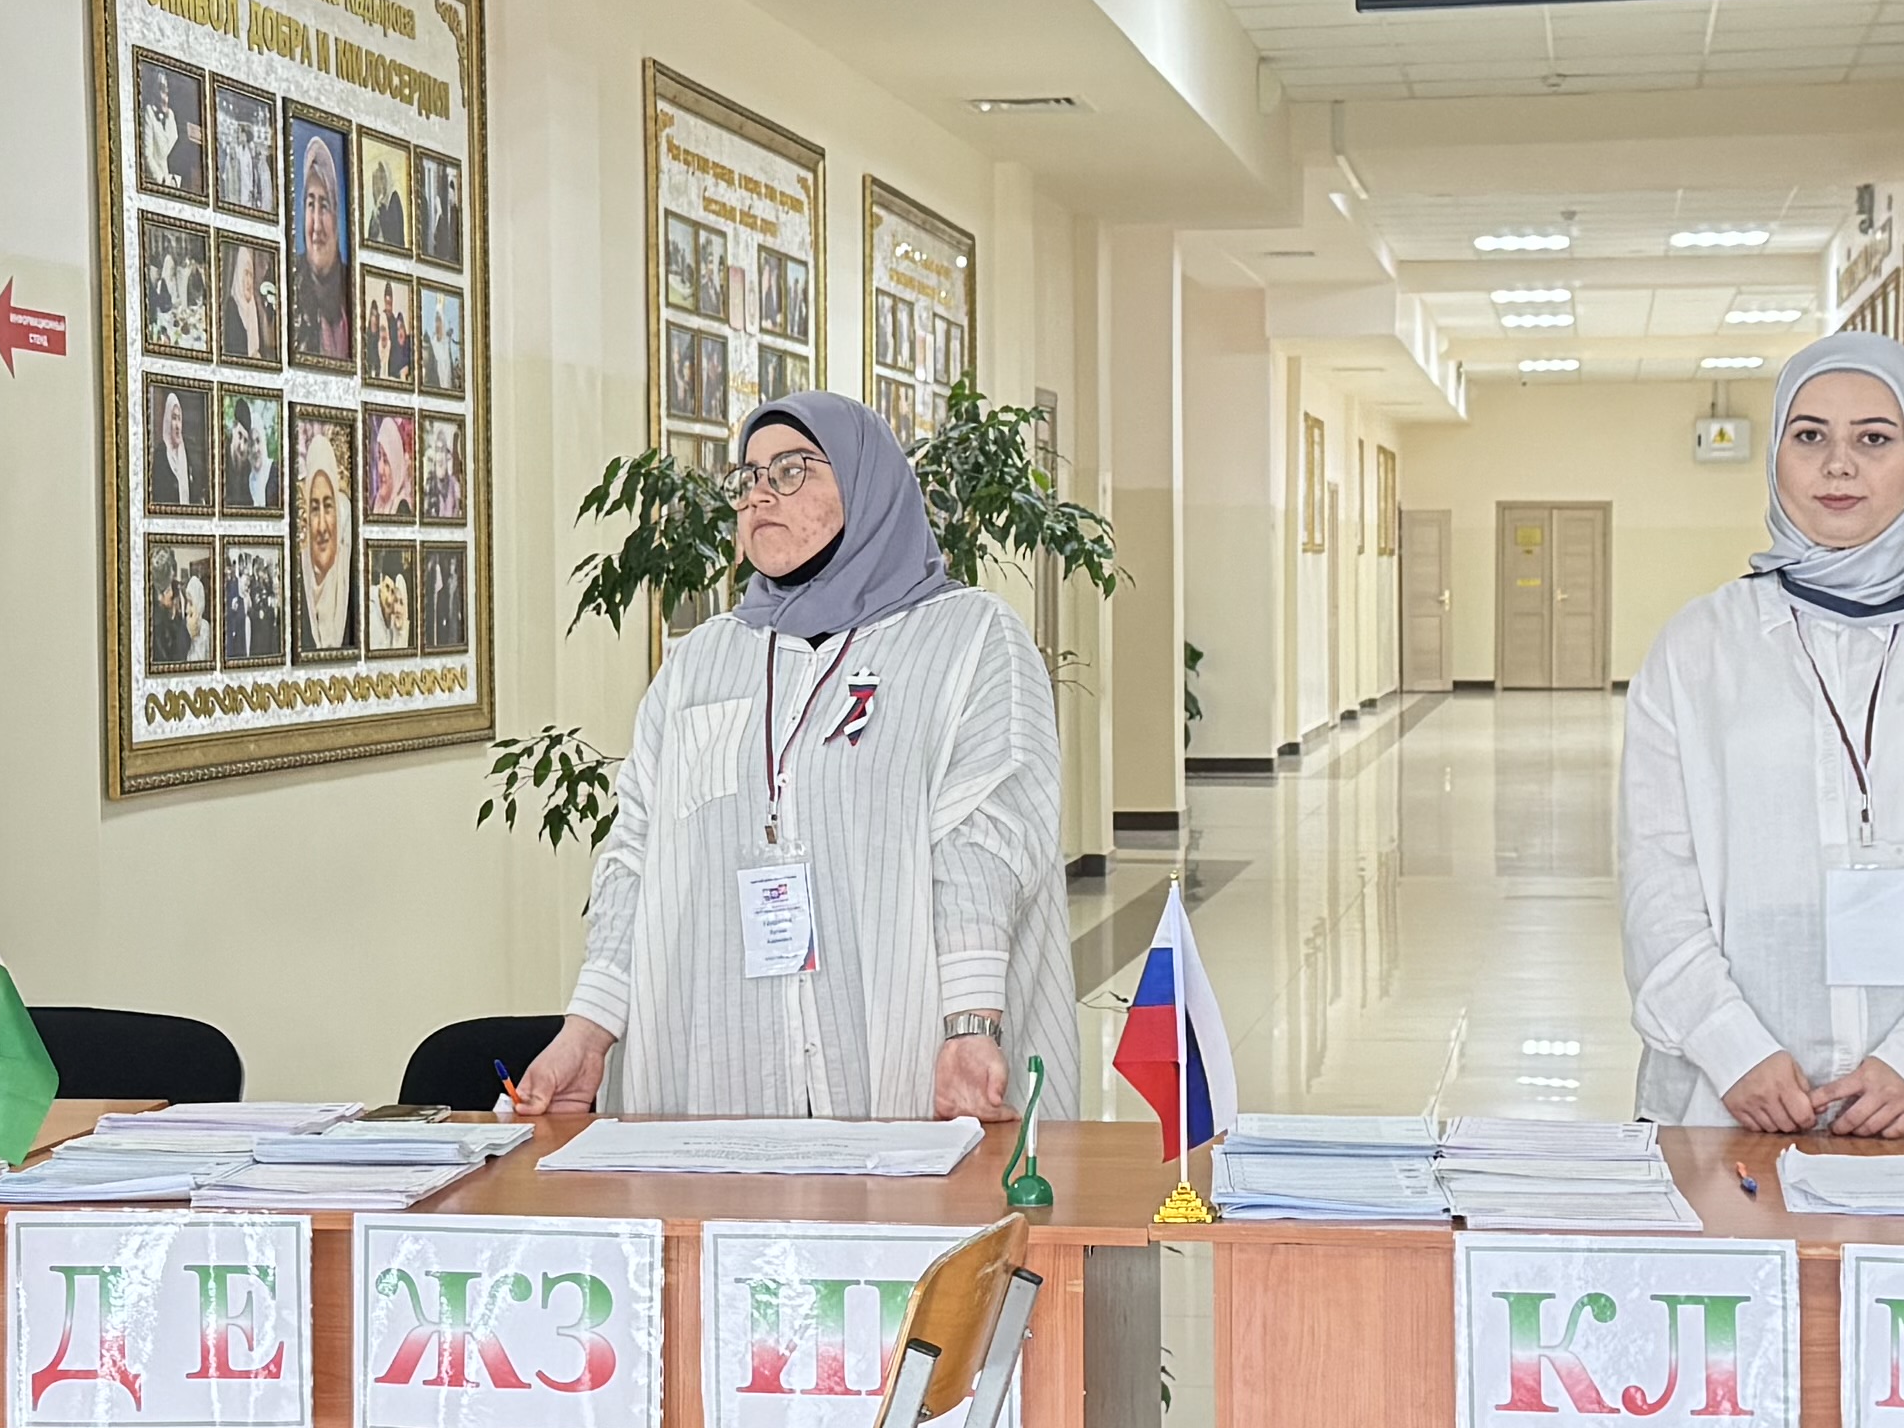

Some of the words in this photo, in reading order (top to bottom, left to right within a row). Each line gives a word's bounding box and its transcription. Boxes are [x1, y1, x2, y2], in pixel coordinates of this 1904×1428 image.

[317, 29, 332, 74] И
[334, 36, 451, 120] МИЛОСЕРДИЯ
[373, 1268, 616, 1395] ЖЗ
[1491, 1290, 1756, 1418] КЛ
